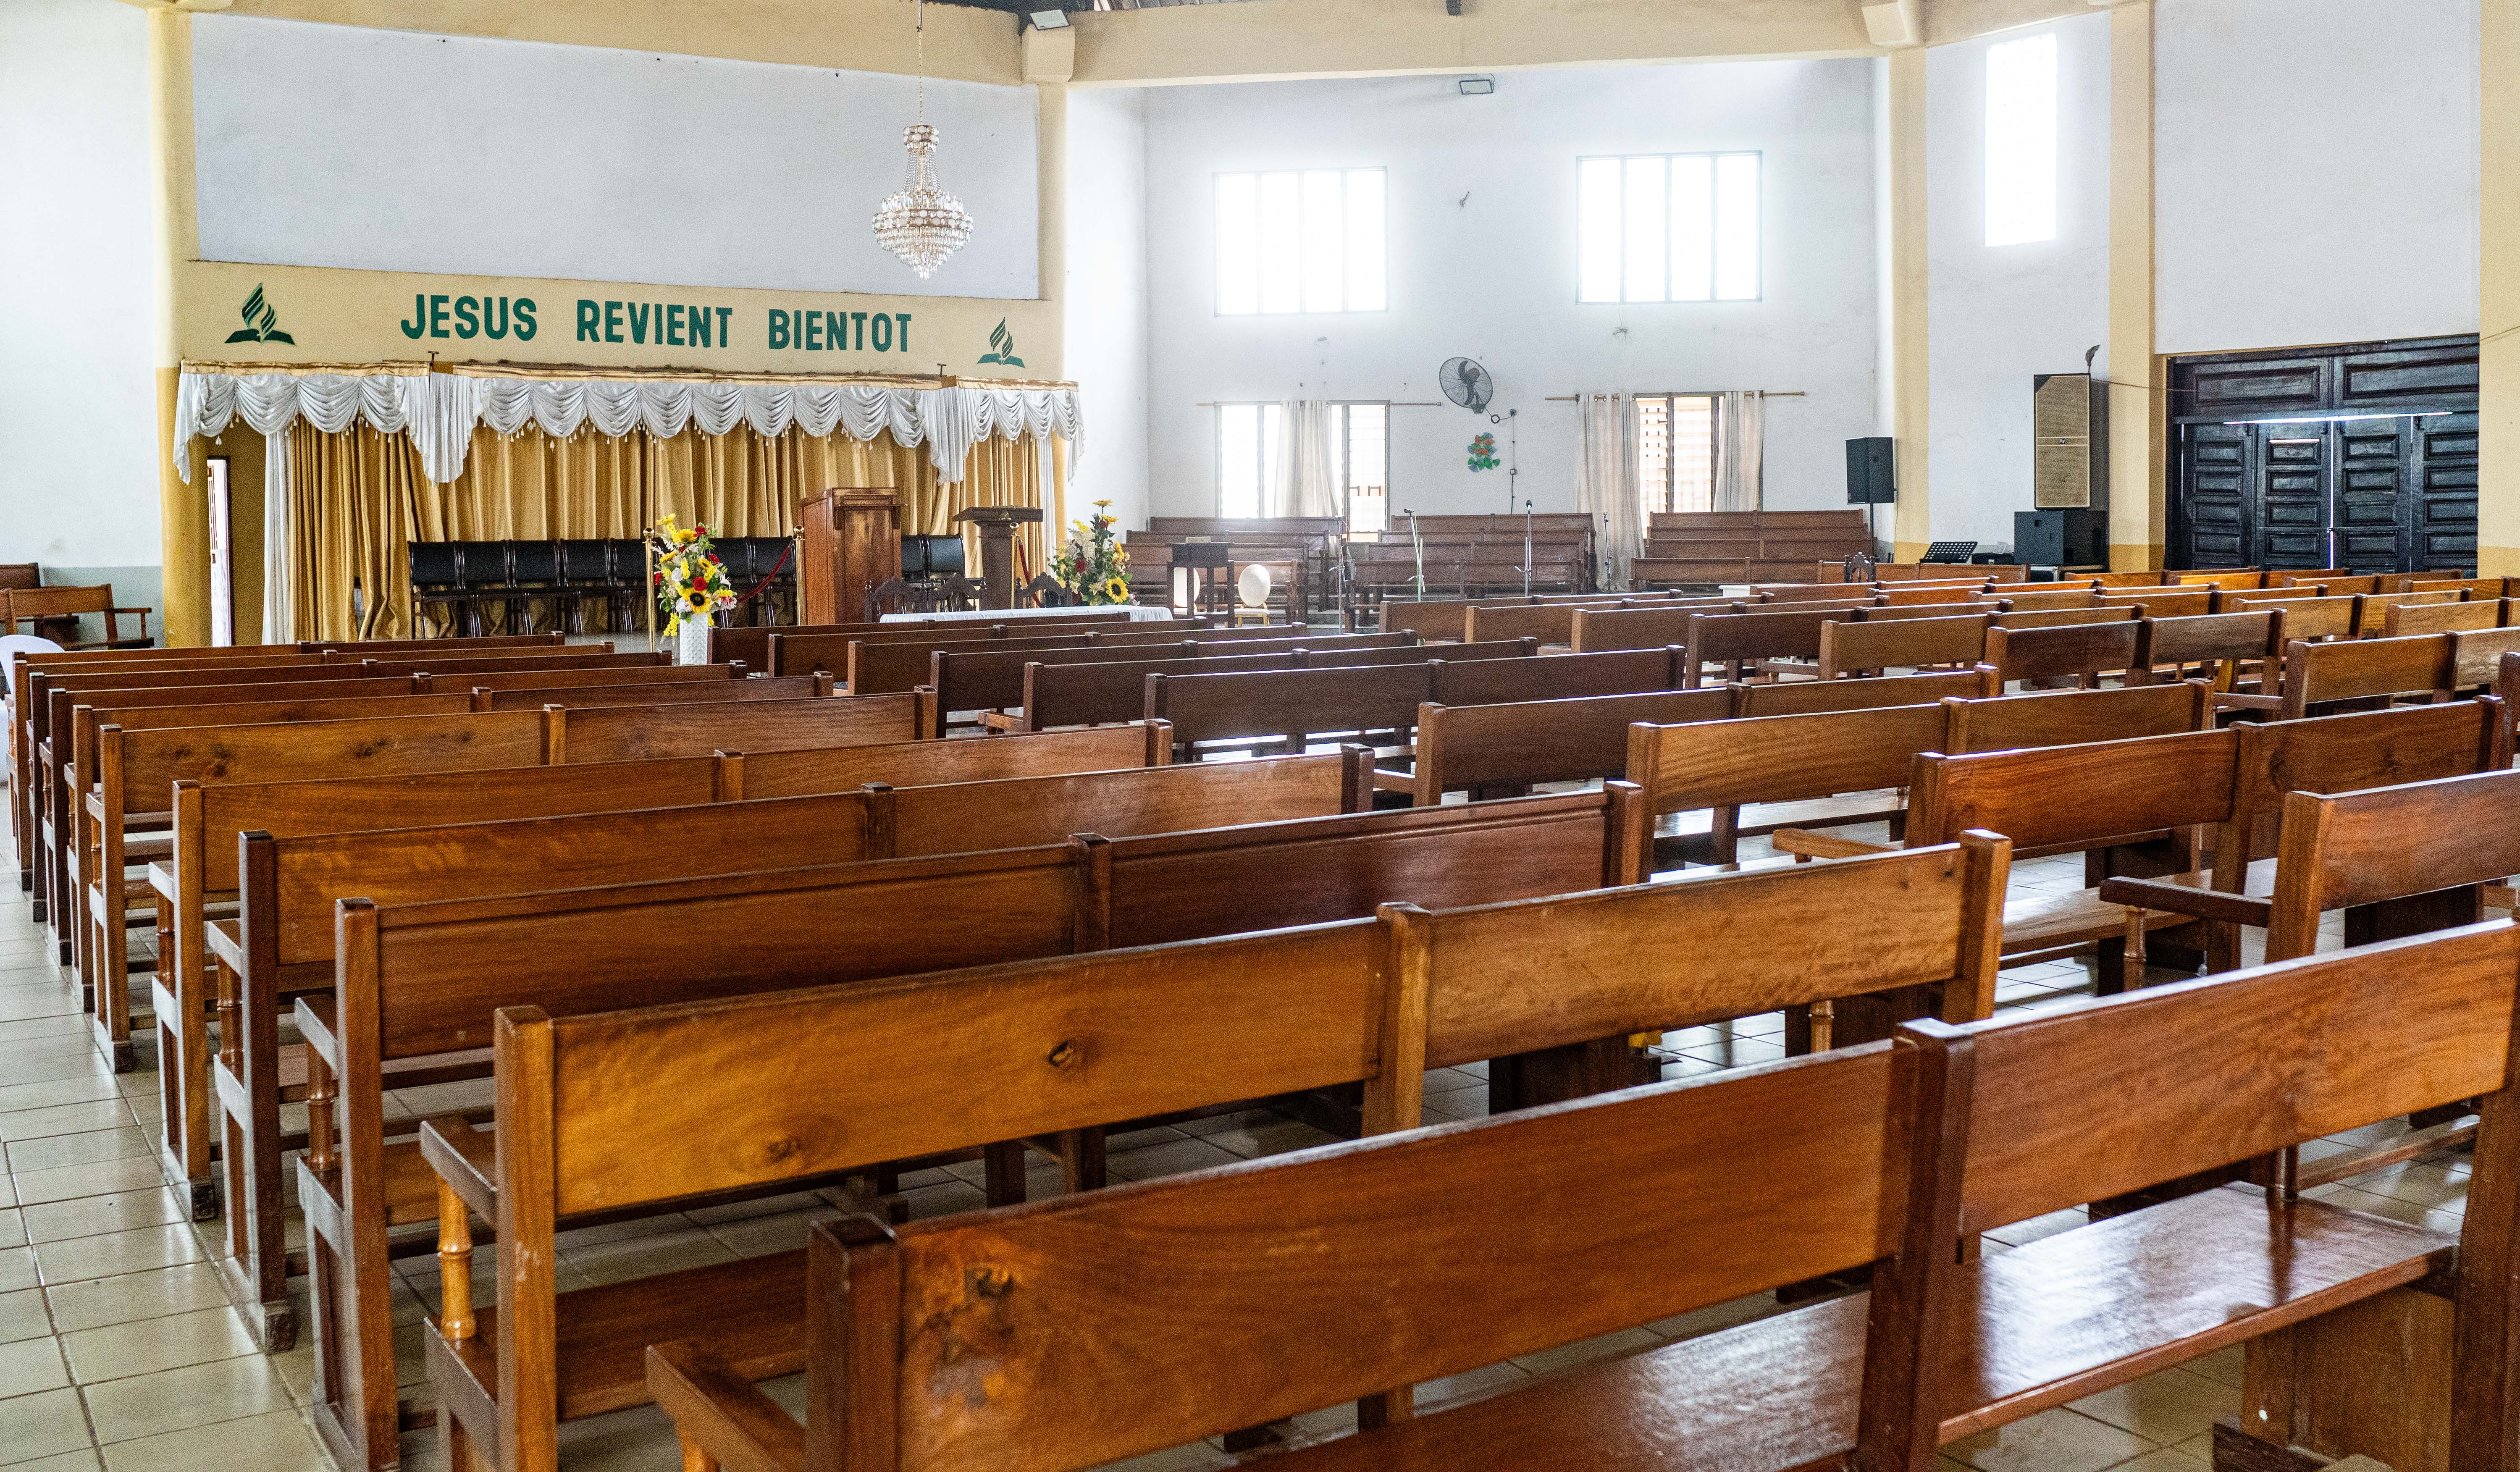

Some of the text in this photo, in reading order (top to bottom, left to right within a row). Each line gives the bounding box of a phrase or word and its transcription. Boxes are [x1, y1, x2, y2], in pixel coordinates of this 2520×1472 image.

[401, 294, 911, 352] JESUS REVIENT BIENTOT
